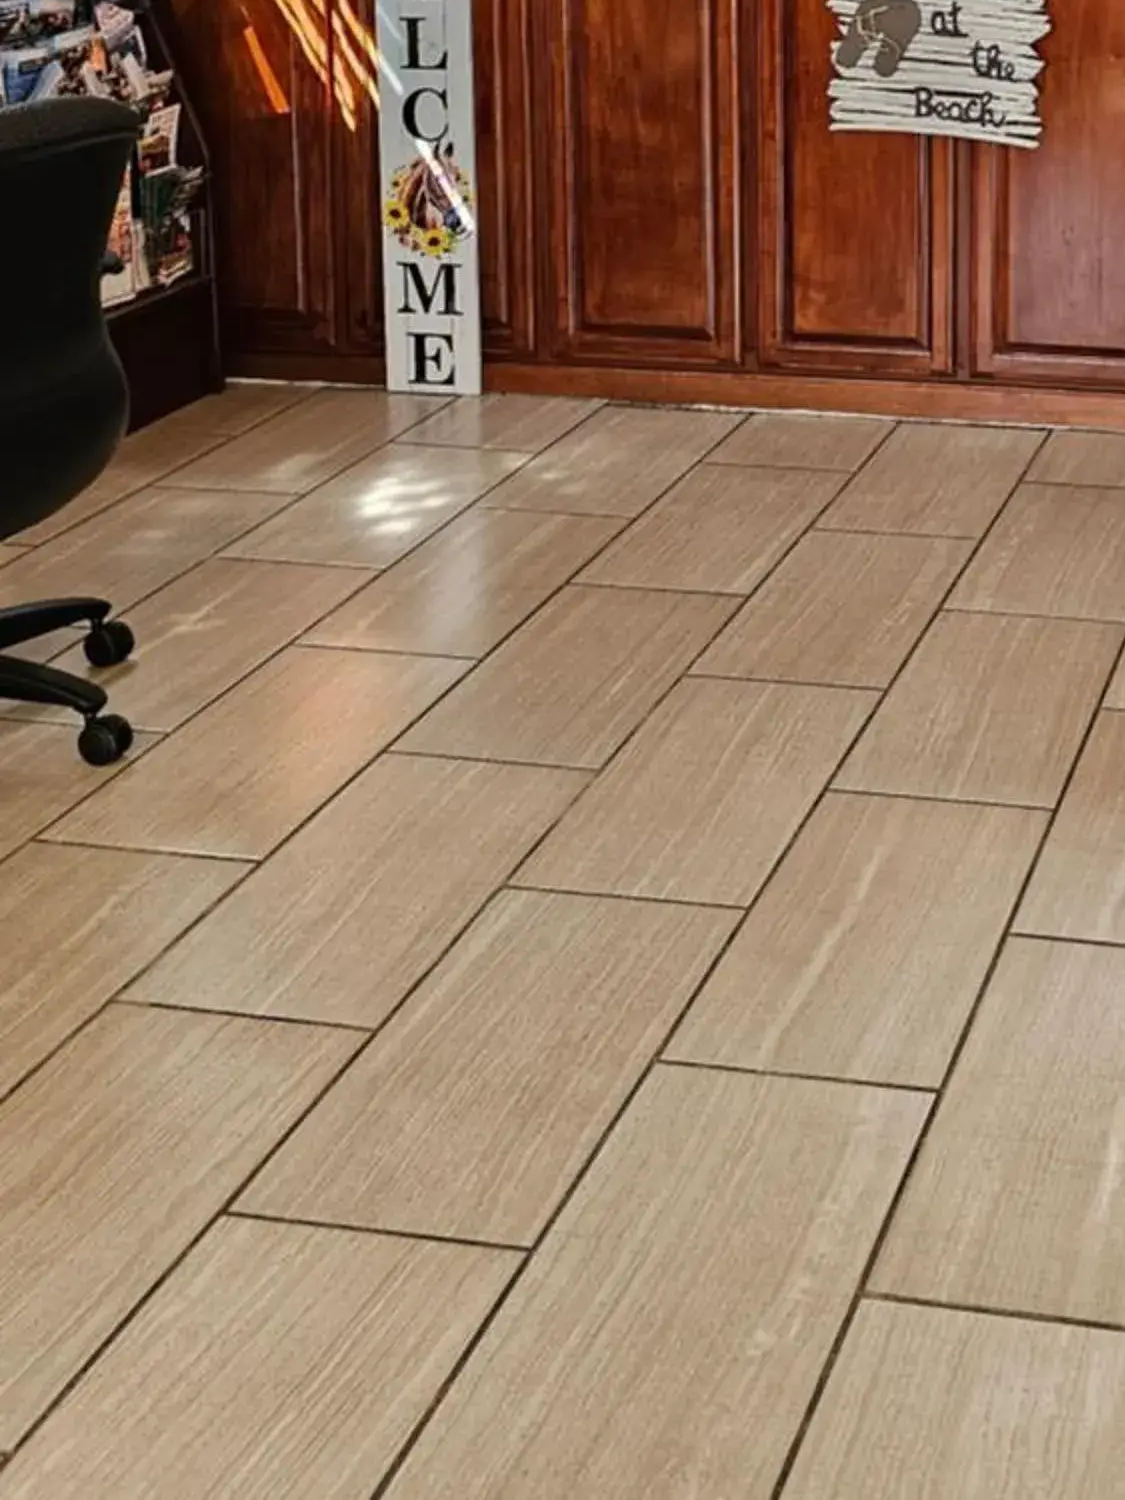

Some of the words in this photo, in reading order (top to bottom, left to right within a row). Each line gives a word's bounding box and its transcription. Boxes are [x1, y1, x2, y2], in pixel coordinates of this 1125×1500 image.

[931, 1, 969, 37] at
[968, 40, 1018, 83] the
[914, 86, 1007, 128] Beach
